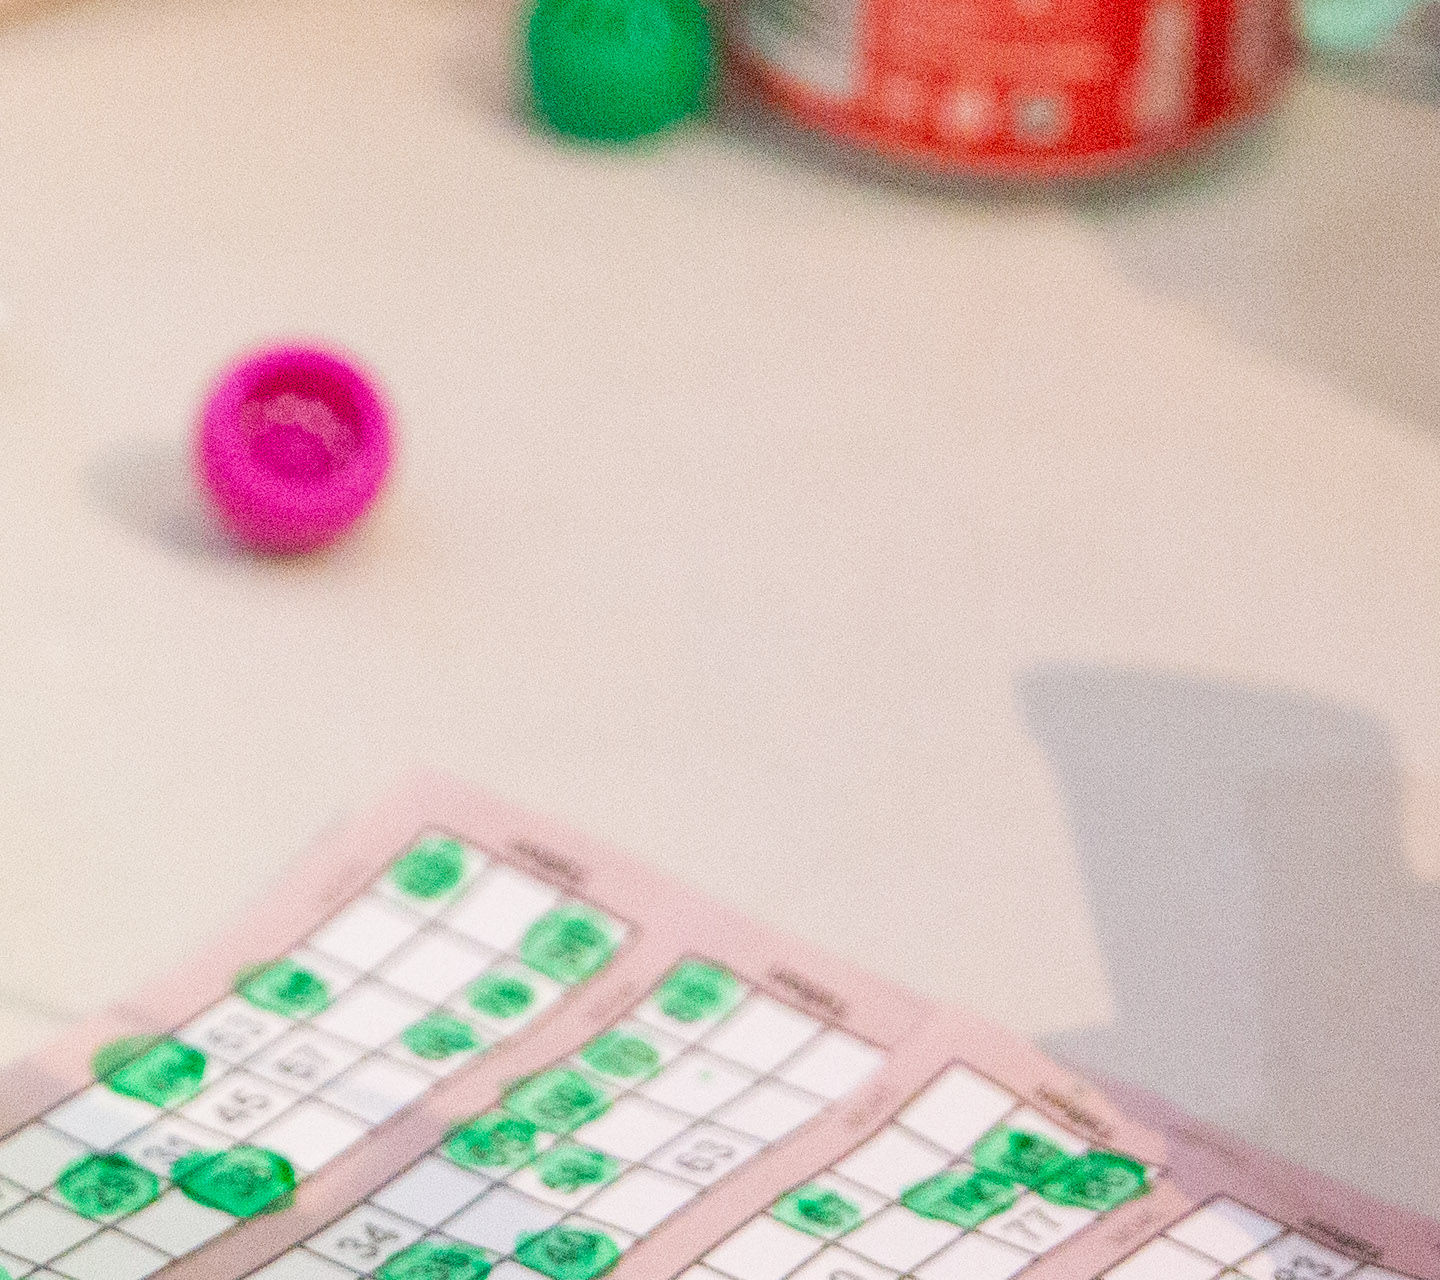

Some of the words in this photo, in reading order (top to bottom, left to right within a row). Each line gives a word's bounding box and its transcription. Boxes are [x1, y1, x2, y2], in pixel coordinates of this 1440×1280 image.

[216, 1085, 272, 1123] 45
[674, 1138, 738, 1173] 63
[336, 1223, 400, 1260] 34
[1002, 1205, 1061, 1242] 77
